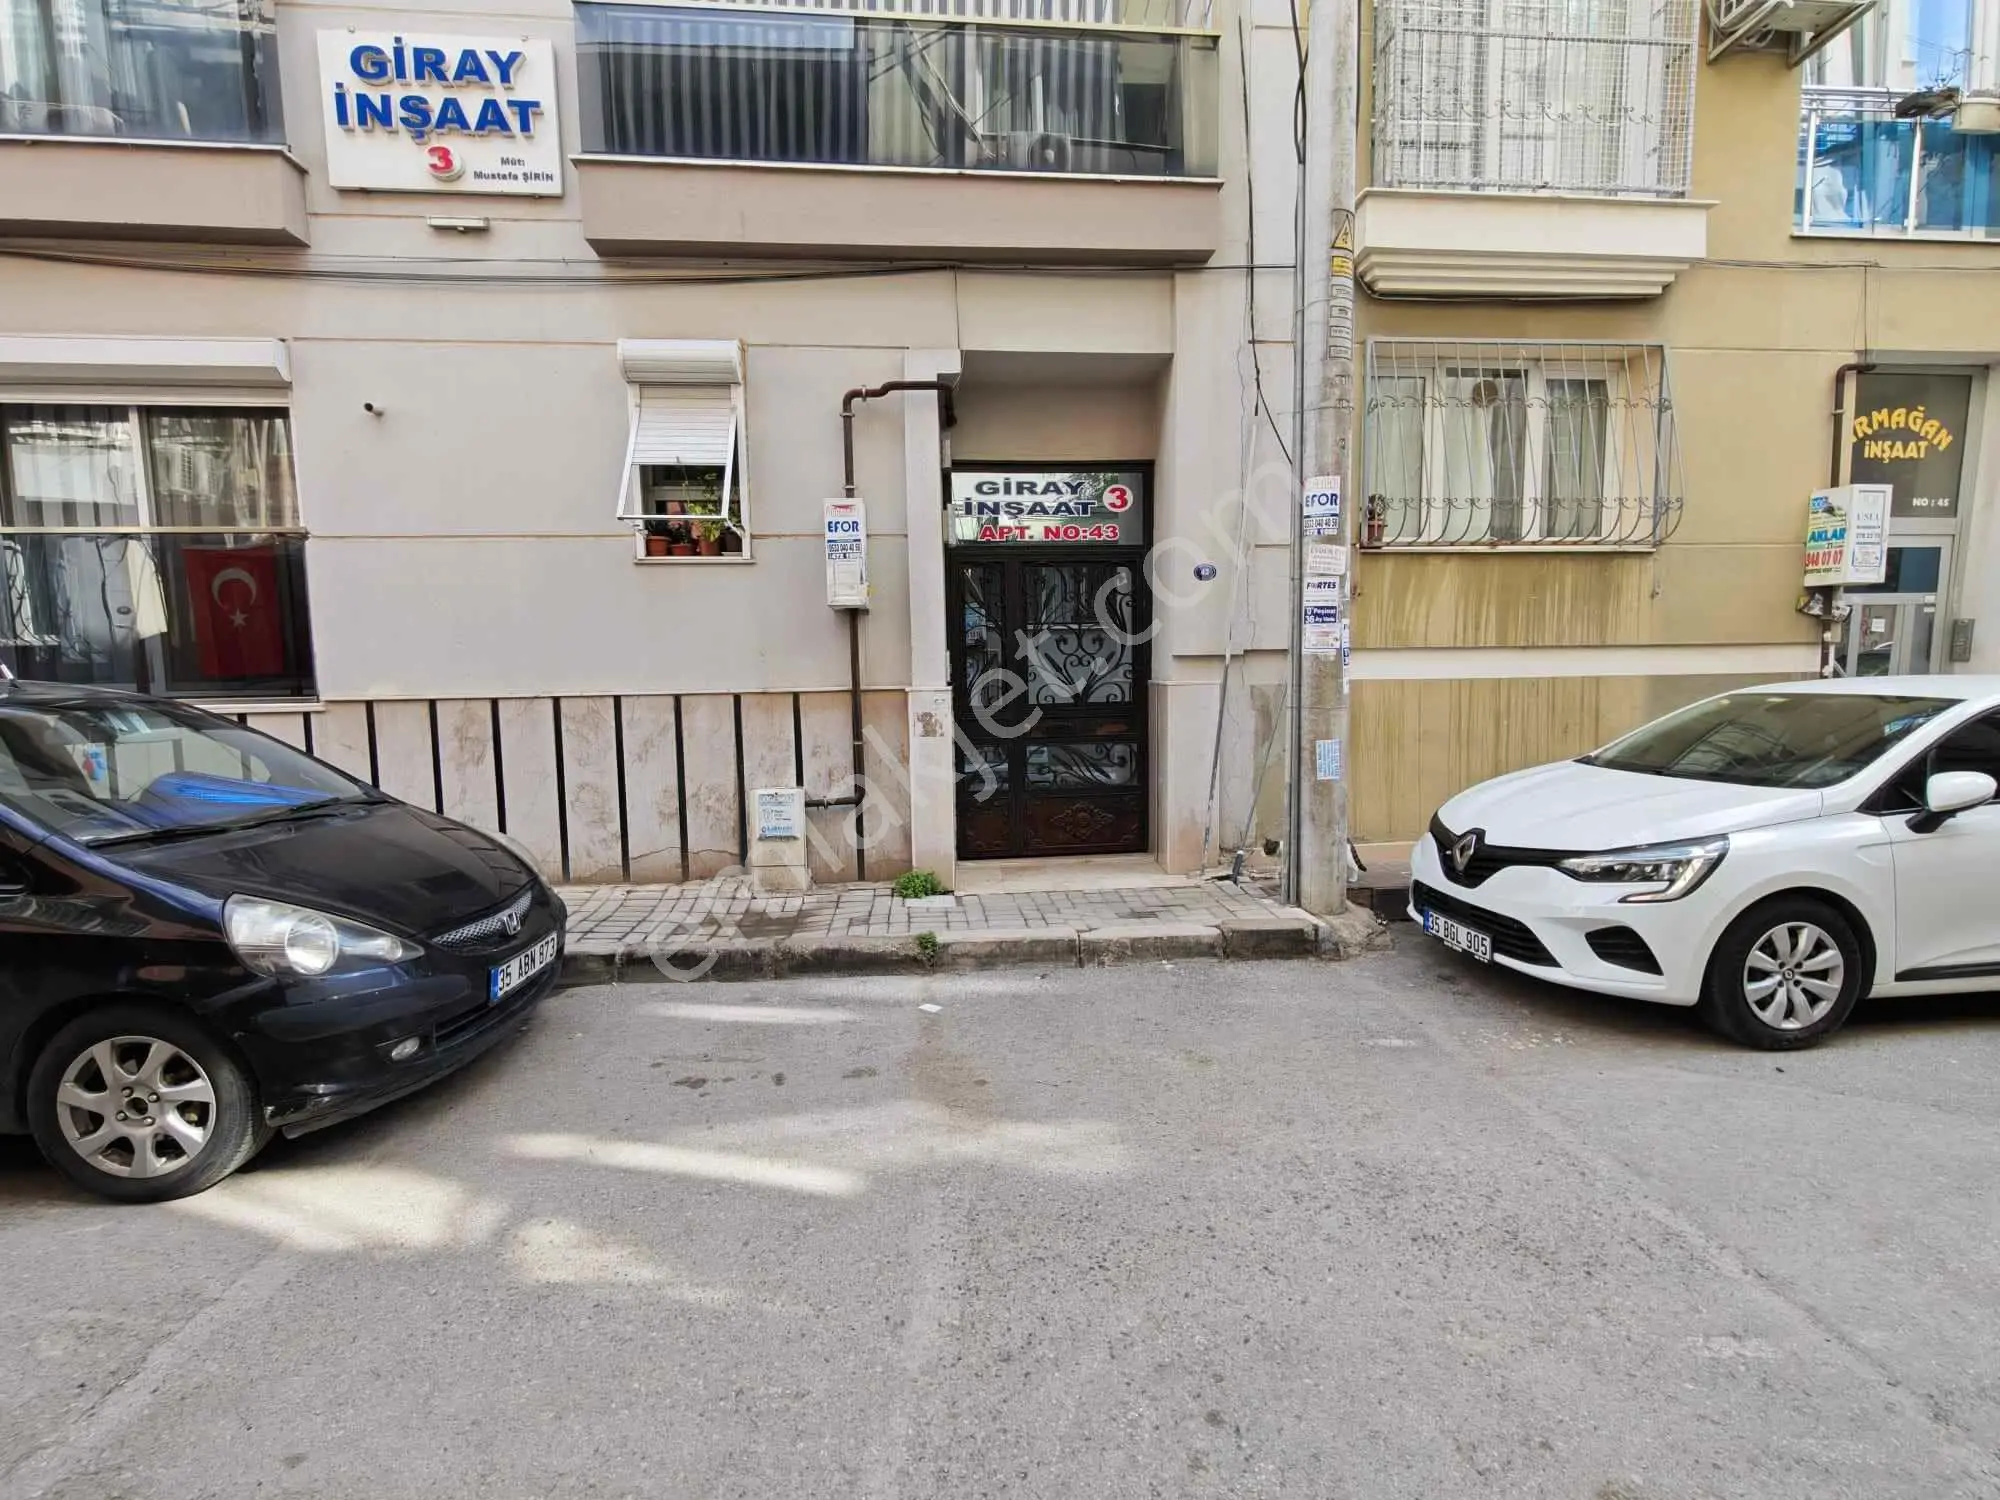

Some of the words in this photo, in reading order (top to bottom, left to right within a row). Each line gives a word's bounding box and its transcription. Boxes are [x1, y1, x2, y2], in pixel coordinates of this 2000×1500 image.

[350, 36, 527, 90] GİRAY
[334, 82, 544, 145] İNŞAAT
[427, 146, 455, 173] 3
[473, 171, 518, 181] Mustafa
[1851, 405, 1953, 452] RMAĞAN
[1863, 440, 1929, 464] İNŞAAT
[975, 477, 1086, 496] GİRAY
[1107, 487, 1129, 509] 3
[963, 498, 1096, 519] İNŞAAT
[1305, 493, 1338, 508] EFOR
[827, 520, 859, 533] EFOR
[979, 525, 1034, 540] APT.
[1043, 524, 1119, 540] NO:43
[1429, 914, 1440, 934] 35
[1443, 921, 1462, 945] BGL
[1466, 932, 1488, 955] 905
[499, 965, 511, 991] 35
[519, 948, 536, 979] ABN
[539, 937, 556, 964] 873
